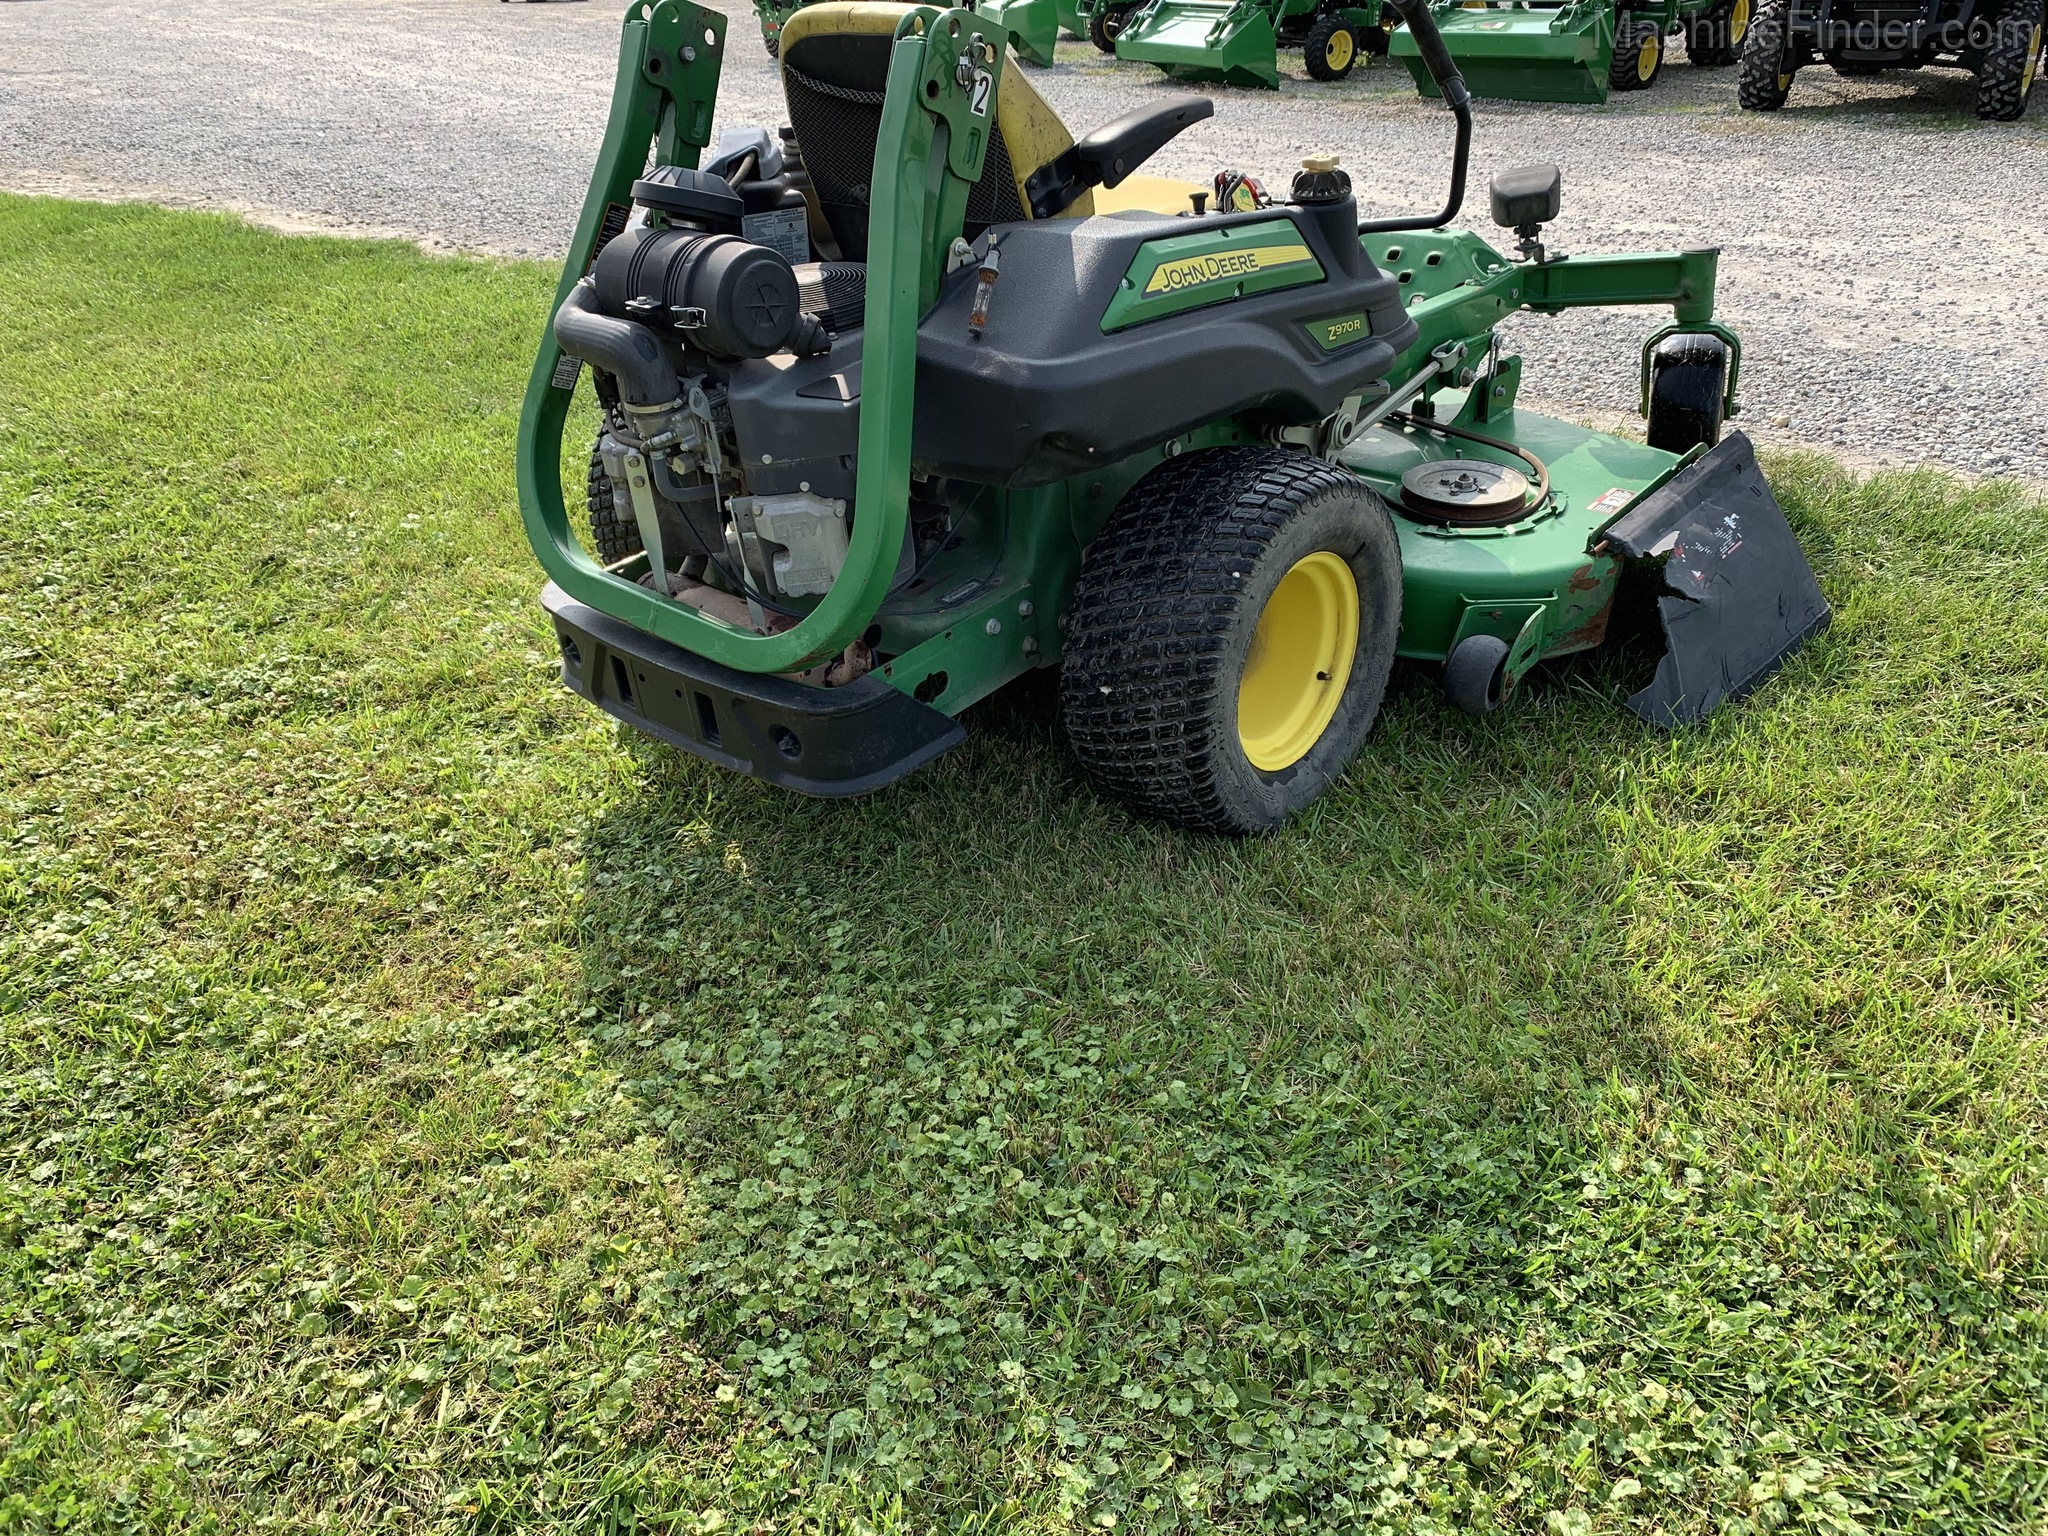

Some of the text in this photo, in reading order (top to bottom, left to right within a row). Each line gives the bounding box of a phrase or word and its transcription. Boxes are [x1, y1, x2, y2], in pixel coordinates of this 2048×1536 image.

[973, 75, 990, 115] 2
[1162, 253, 1260, 290] JOHN DEERE
[1327, 319, 1361, 341] Z970R
